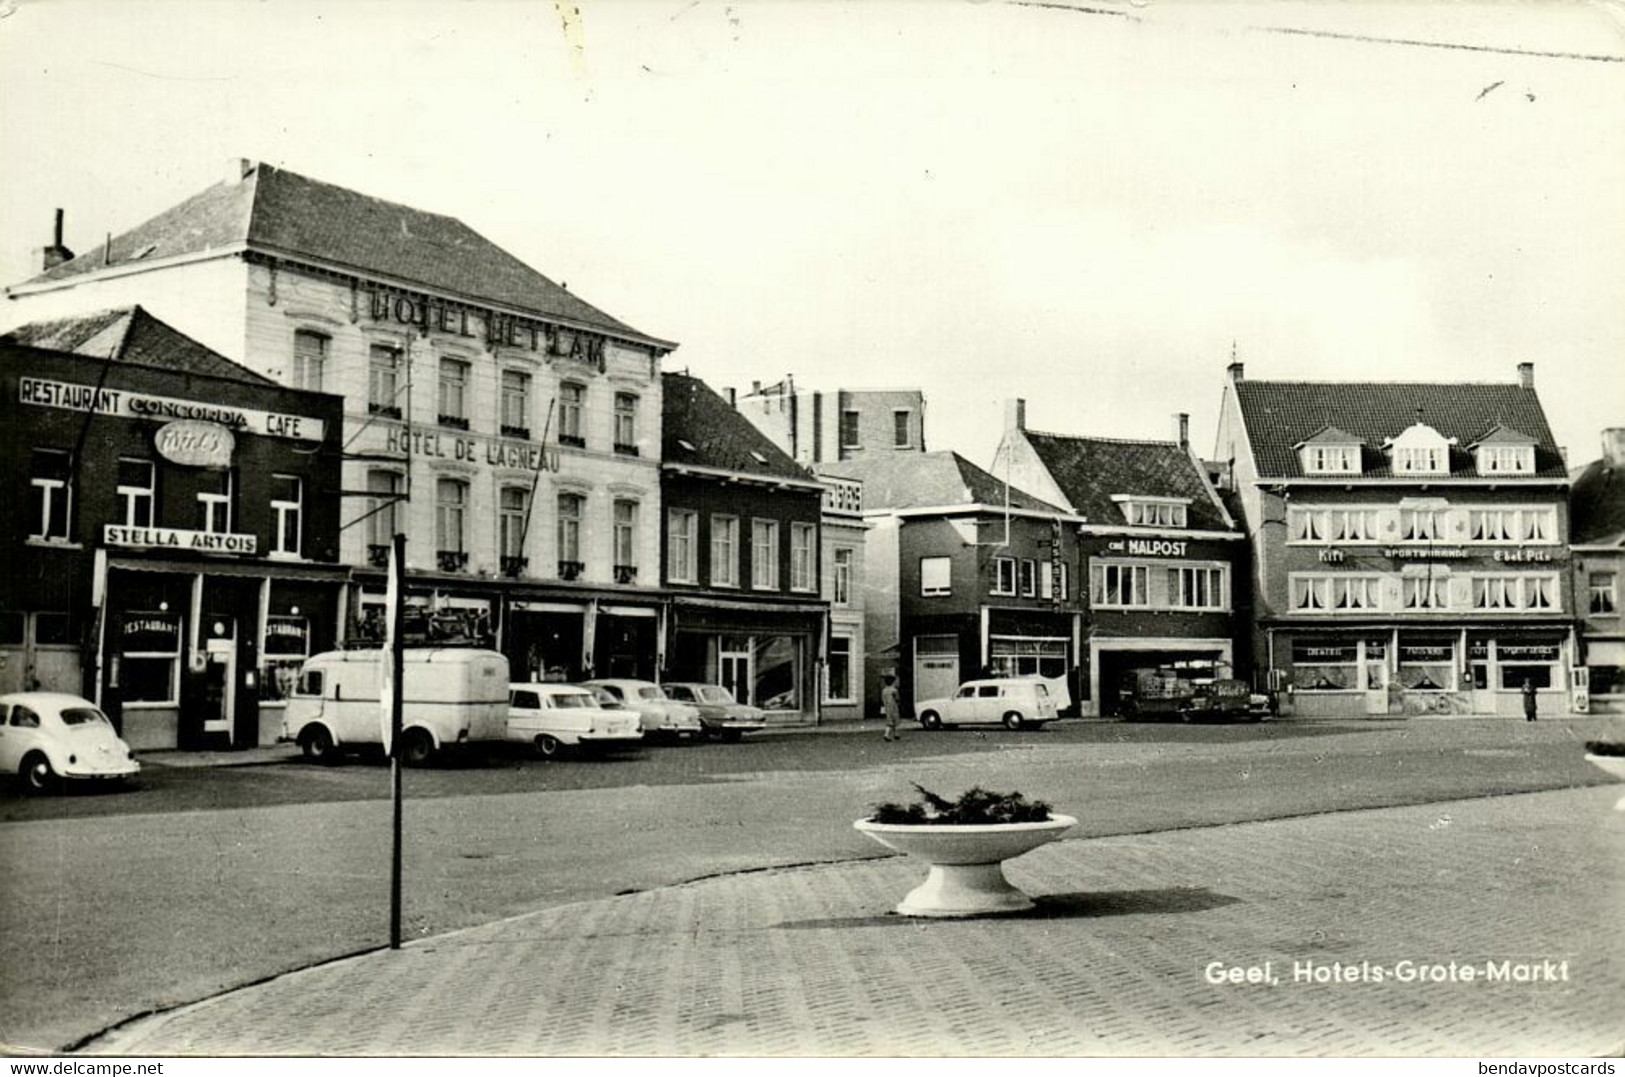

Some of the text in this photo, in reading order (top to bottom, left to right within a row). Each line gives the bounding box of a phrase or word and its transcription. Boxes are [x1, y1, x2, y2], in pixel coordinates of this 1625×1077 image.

[371, 291, 476, 338] HOTEL
[22, 380, 302, 437] RESTAURANT CONCORDIA CAFE
[455, 439, 476, 462] DE
[487, 441, 560, 473] L'AGNEAU
[108, 528, 255, 550] STELLA ARTOIS
[1129, 540, 1187, 556] MALPOST
[266, 624, 307, 638] STAURANT
